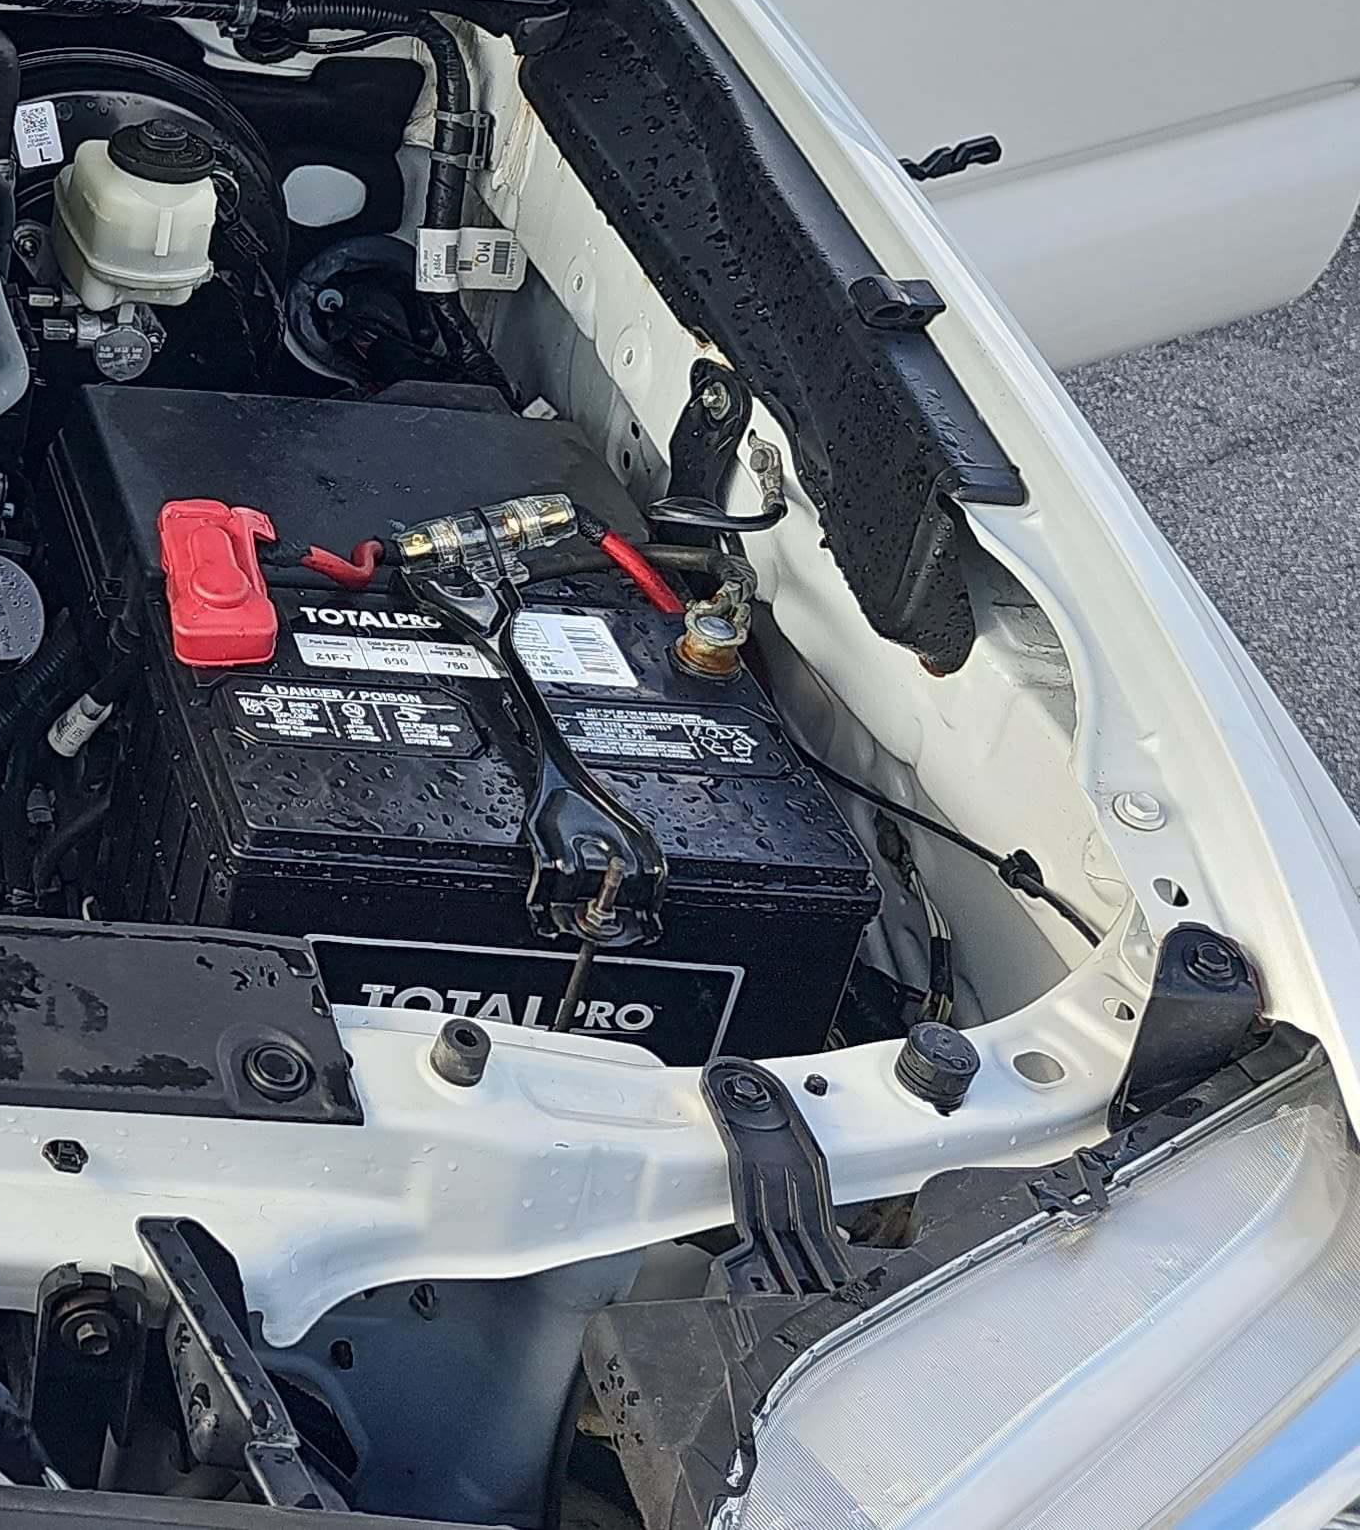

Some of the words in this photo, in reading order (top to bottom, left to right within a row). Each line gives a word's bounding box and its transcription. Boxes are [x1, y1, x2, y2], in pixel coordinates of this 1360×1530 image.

[38, 147, 52, 162] L
[475, 241, 492, 264] MO
[299, 606, 442, 629] TOTALPRO
[275, 684, 344, 699] DANGER
[358, 691, 423, 704] POISON
